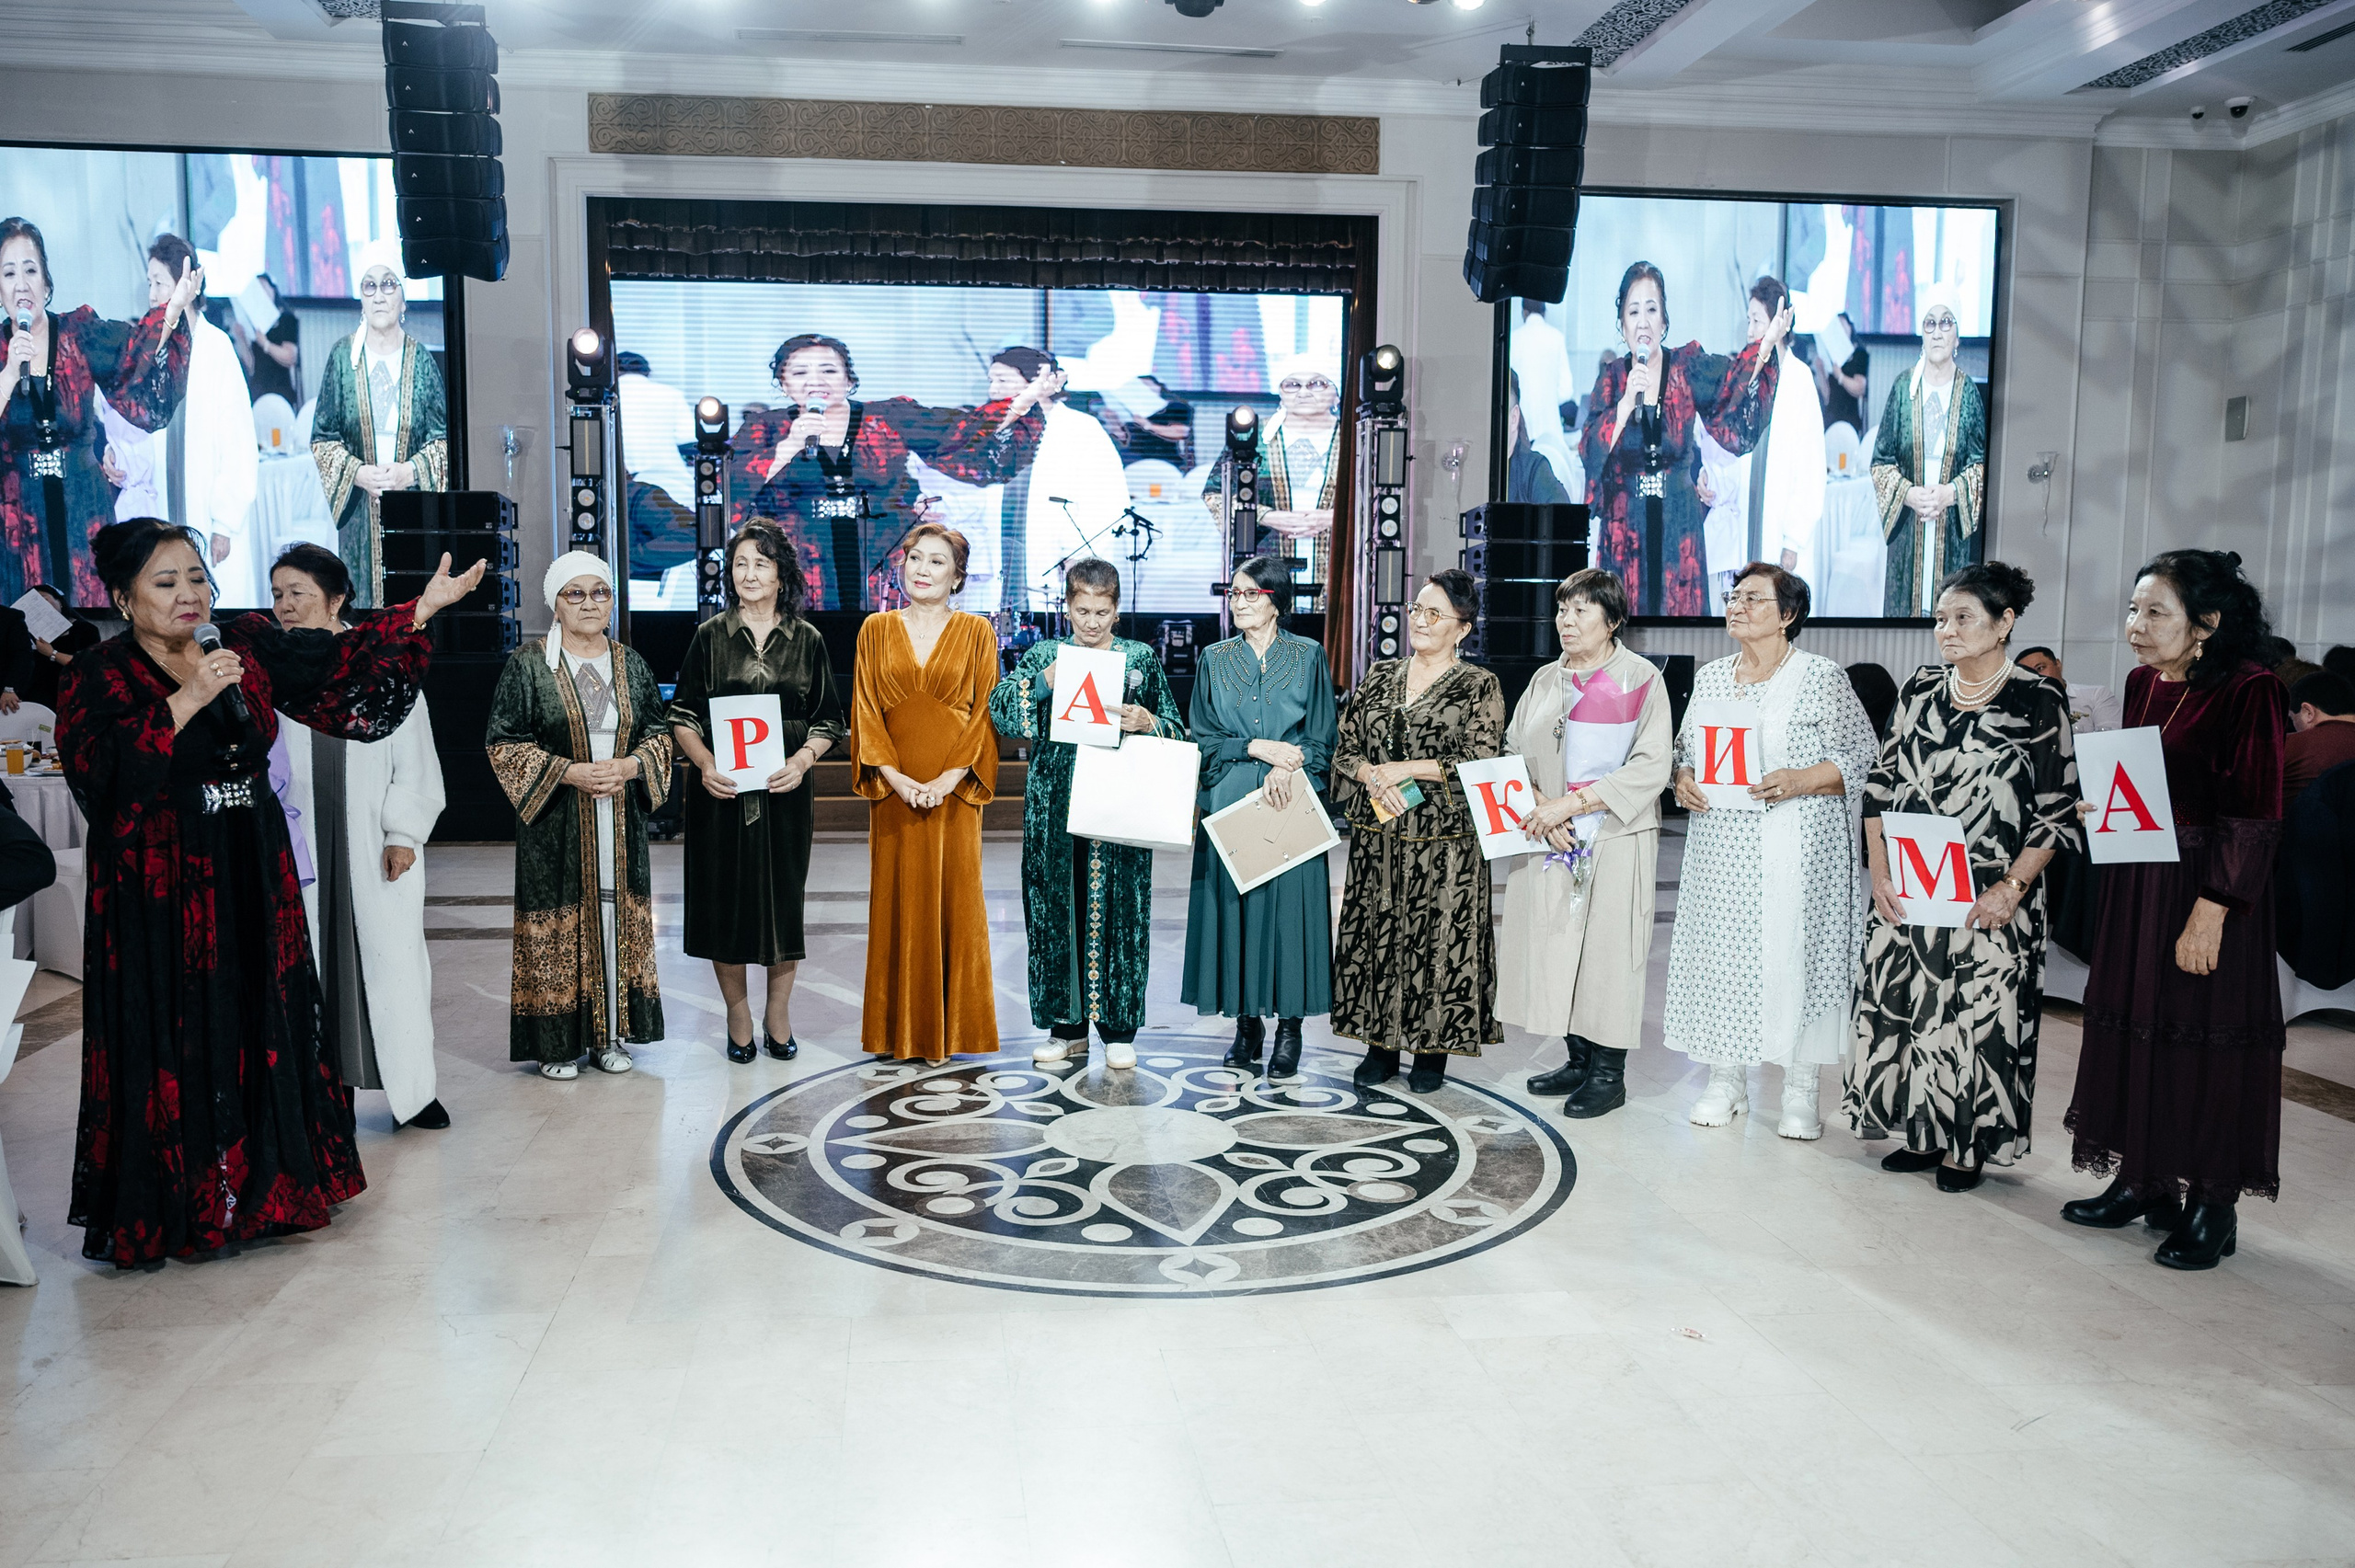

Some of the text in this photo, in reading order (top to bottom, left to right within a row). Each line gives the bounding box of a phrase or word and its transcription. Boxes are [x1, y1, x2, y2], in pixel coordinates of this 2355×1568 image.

[1058, 670, 1112, 726] А
[724, 717, 769, 771] Р
[1697, 725, 1754, 786] И
[1471, 779, 1541, 841] К
[2095, 760, 2165, 833] А
[1889, 835, 1975, 903] М
